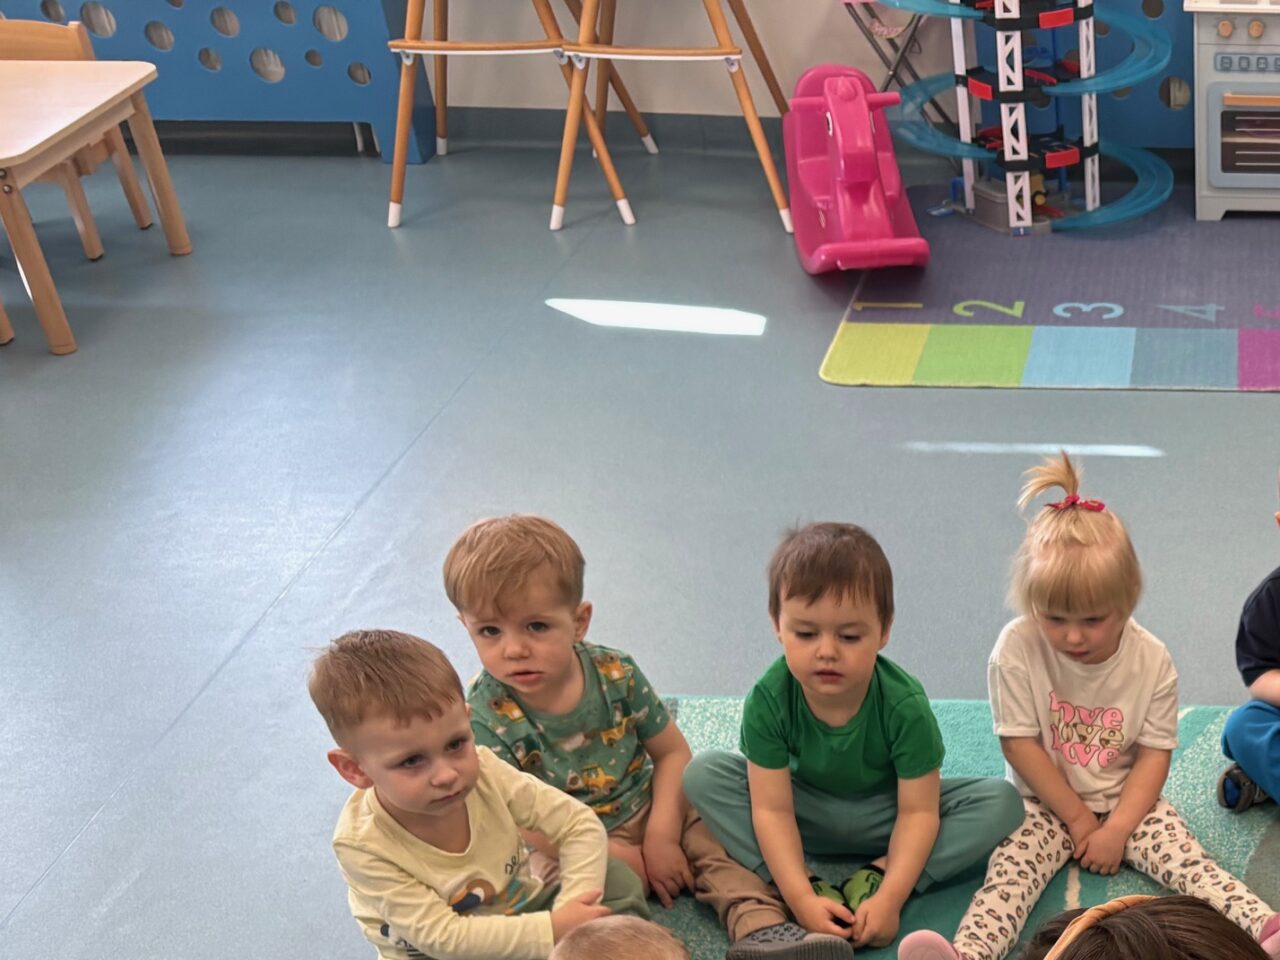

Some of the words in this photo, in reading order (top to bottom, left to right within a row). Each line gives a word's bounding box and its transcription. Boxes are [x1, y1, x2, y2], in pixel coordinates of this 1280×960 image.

[853, 302, 924, 312] 1
[952, 300, 1025, 319] 2
[1052, 302, 1125, 320] 3
[1155, 303, 1226, 322] 4
